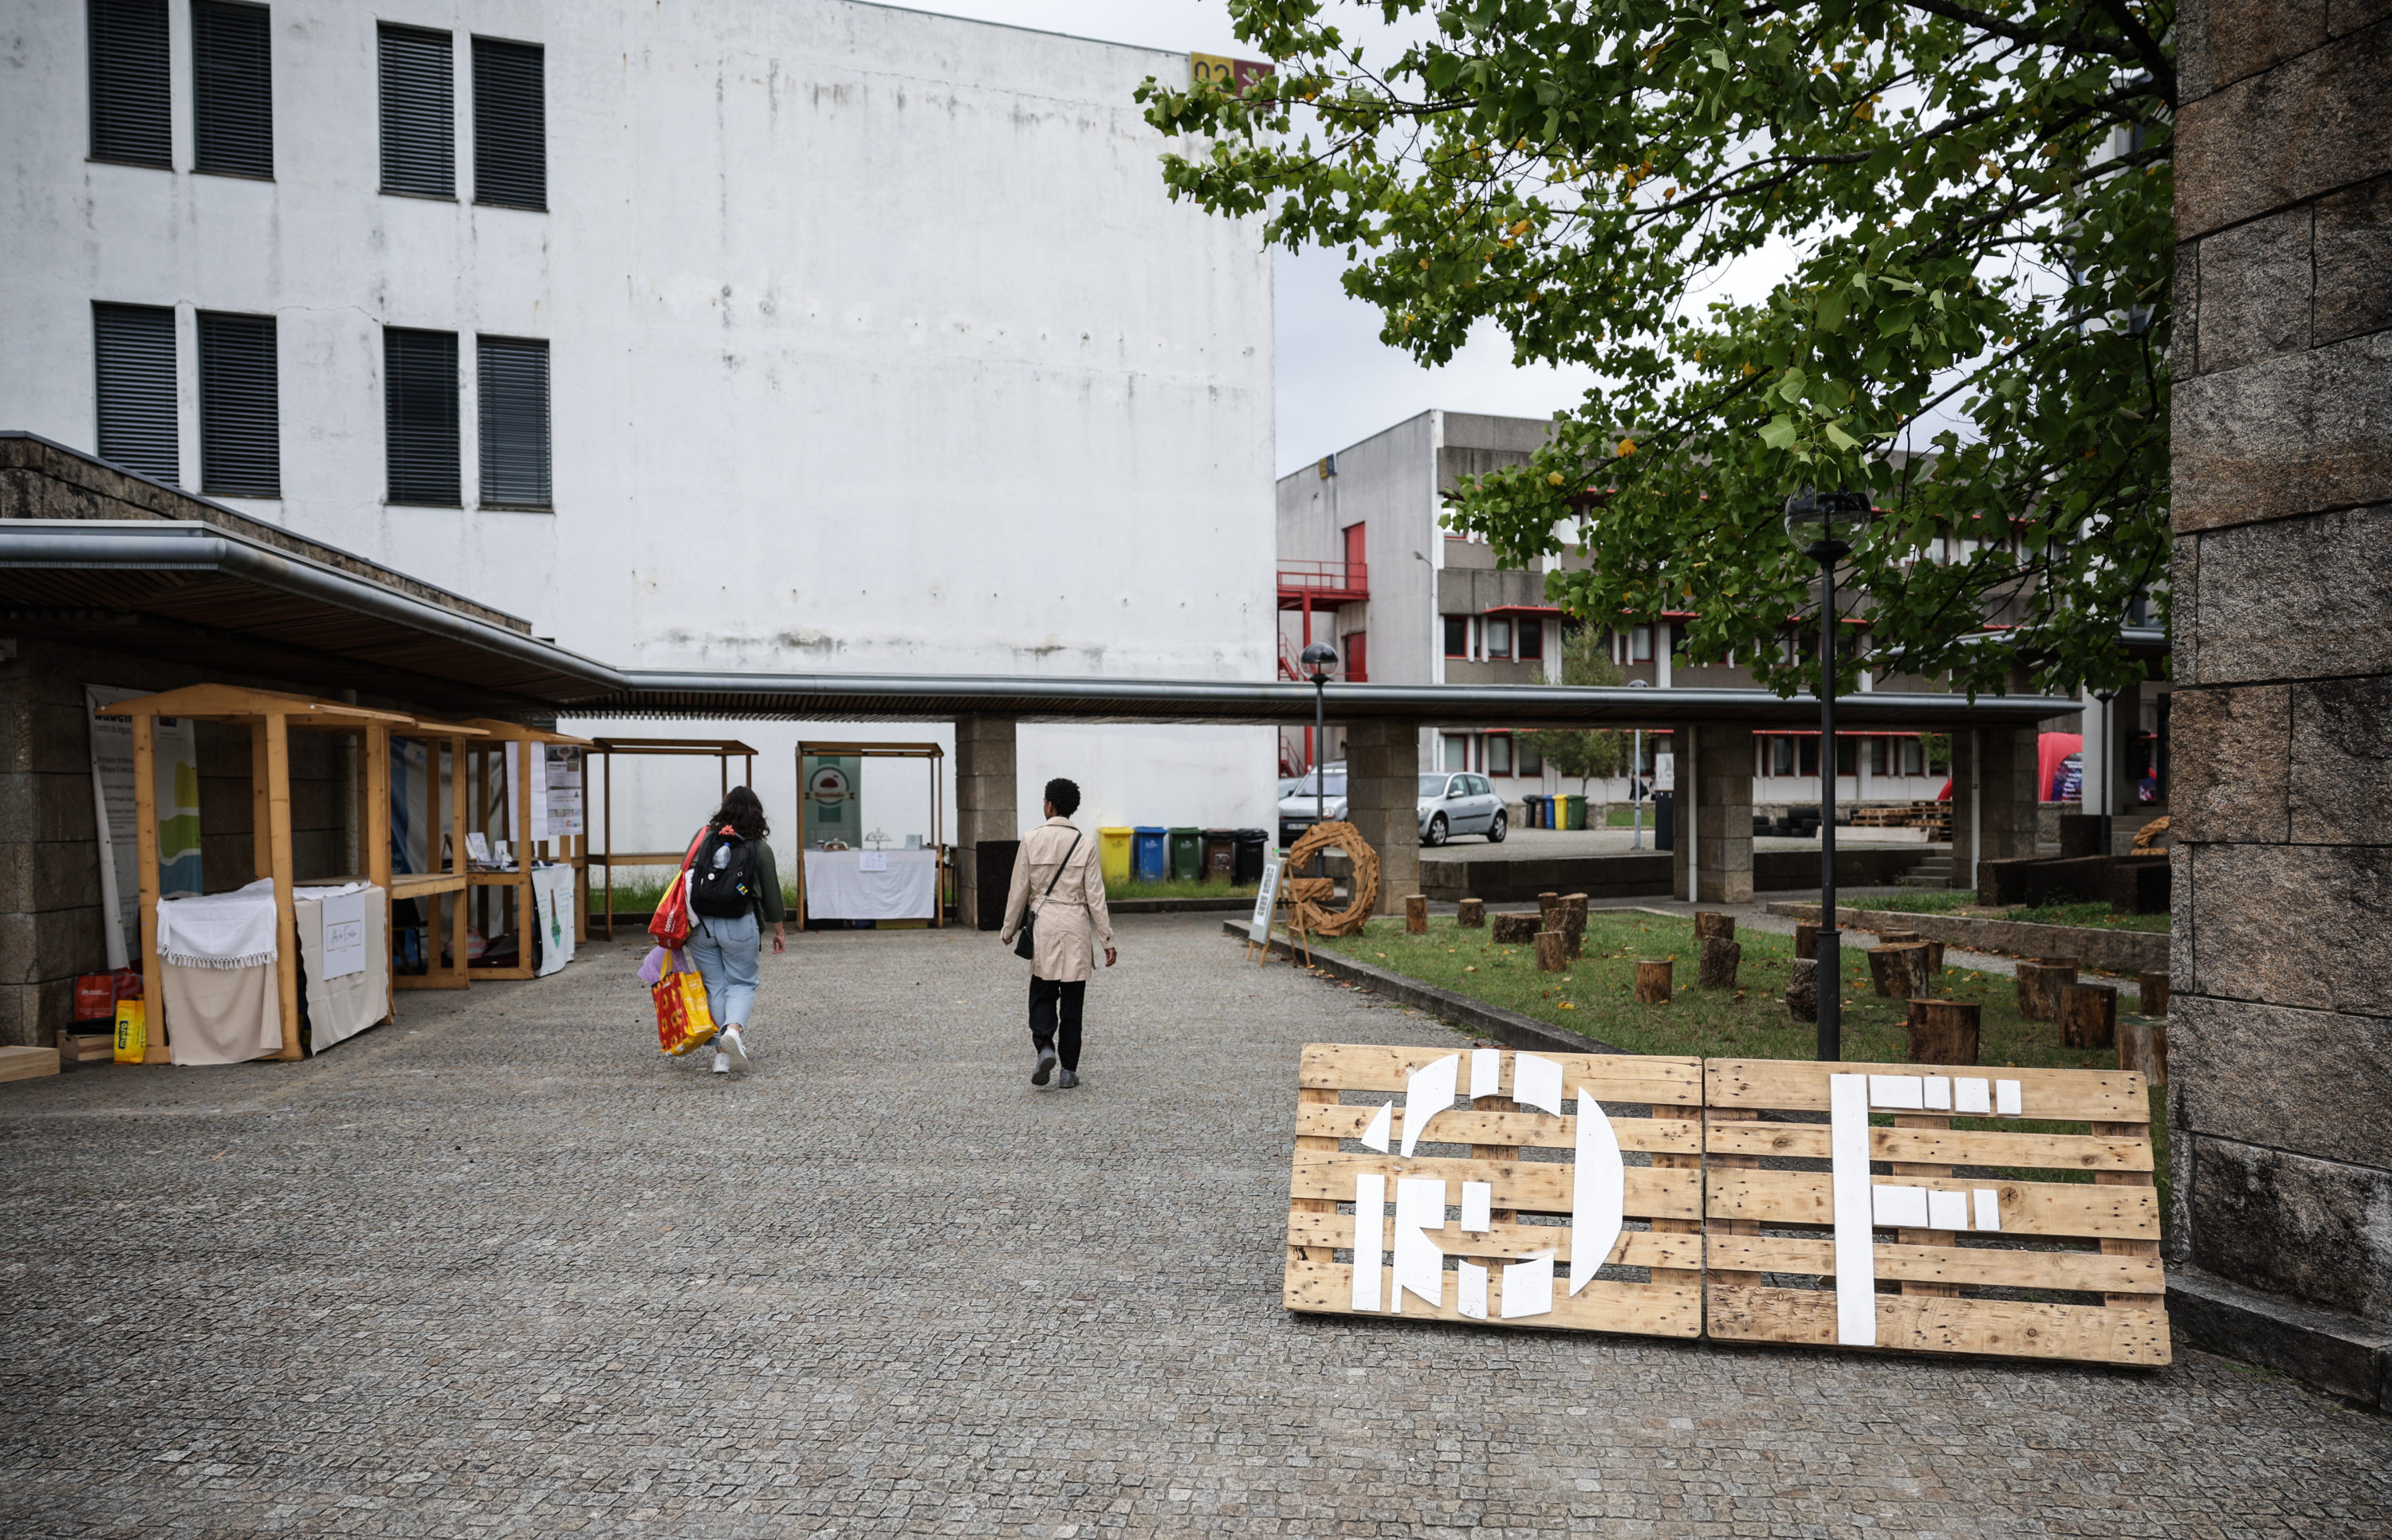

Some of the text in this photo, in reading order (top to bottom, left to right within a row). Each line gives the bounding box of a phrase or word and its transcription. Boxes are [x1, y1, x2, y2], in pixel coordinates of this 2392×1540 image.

[1194, 61, 1230, 93] 02
[94, 724, 110, 733] centro
[111, 725, 116, 733] de
[810, 830, 815, 839] O
[831, 829, 852, 839] PRATO
